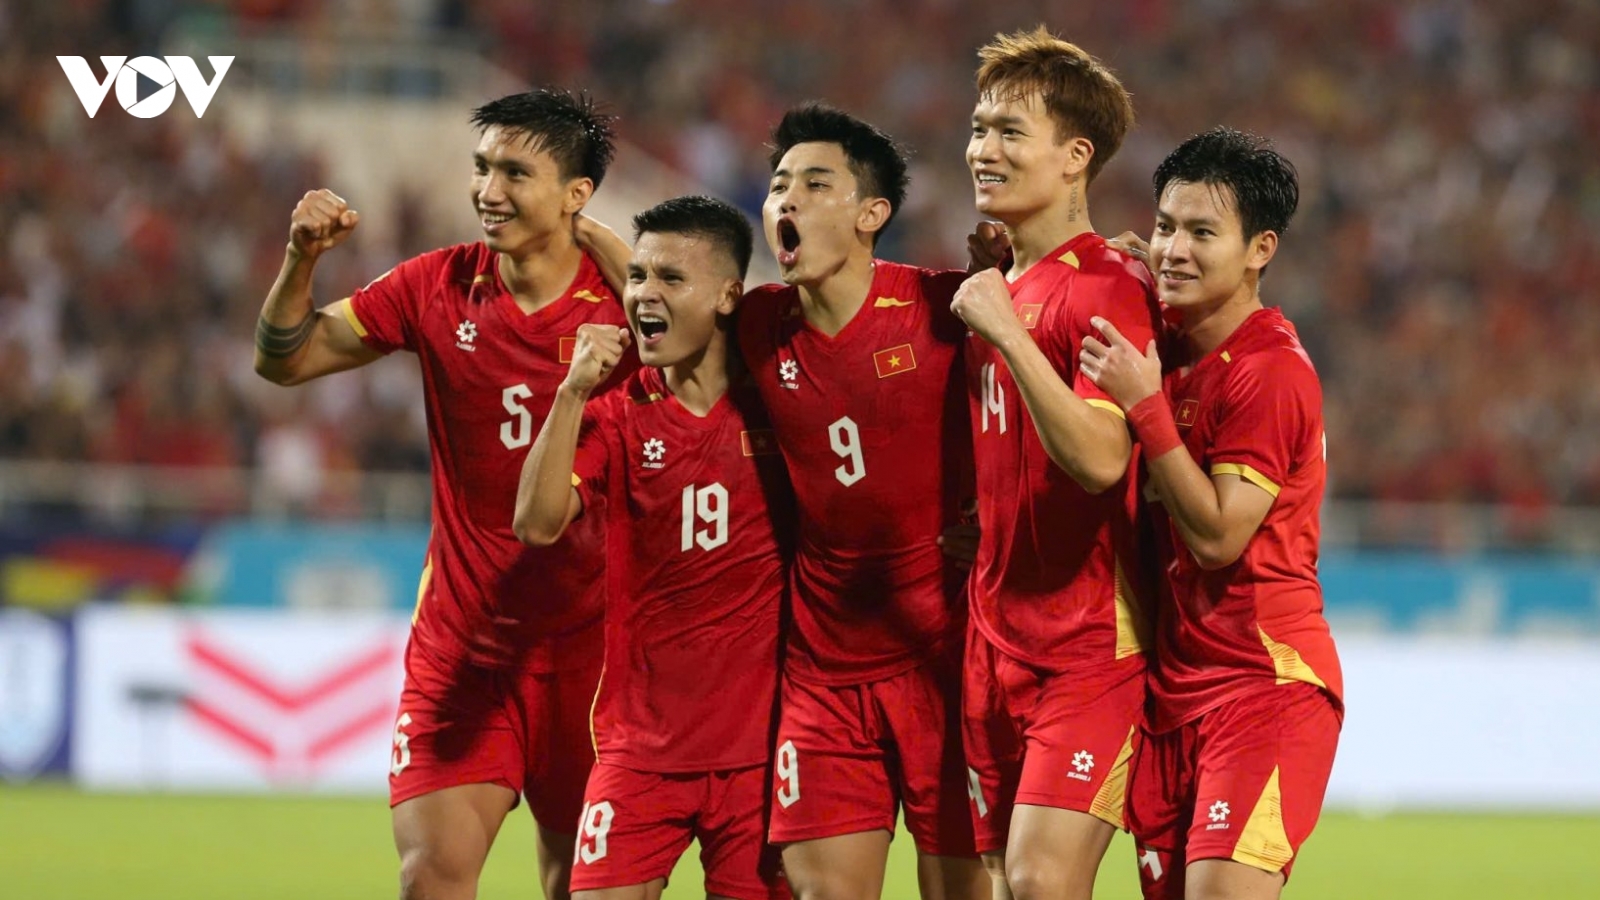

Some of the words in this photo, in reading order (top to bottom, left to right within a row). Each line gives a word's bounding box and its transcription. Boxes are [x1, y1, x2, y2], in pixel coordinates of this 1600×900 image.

[500, 383, 533, 450] 5
[981, 363, 1007, 434] 14
[828, 415, 866, 487] 9
[681, 482, 728, 552] 19
[777, 740, 801, 808] 9
[573, 800, 615, 866] 19
